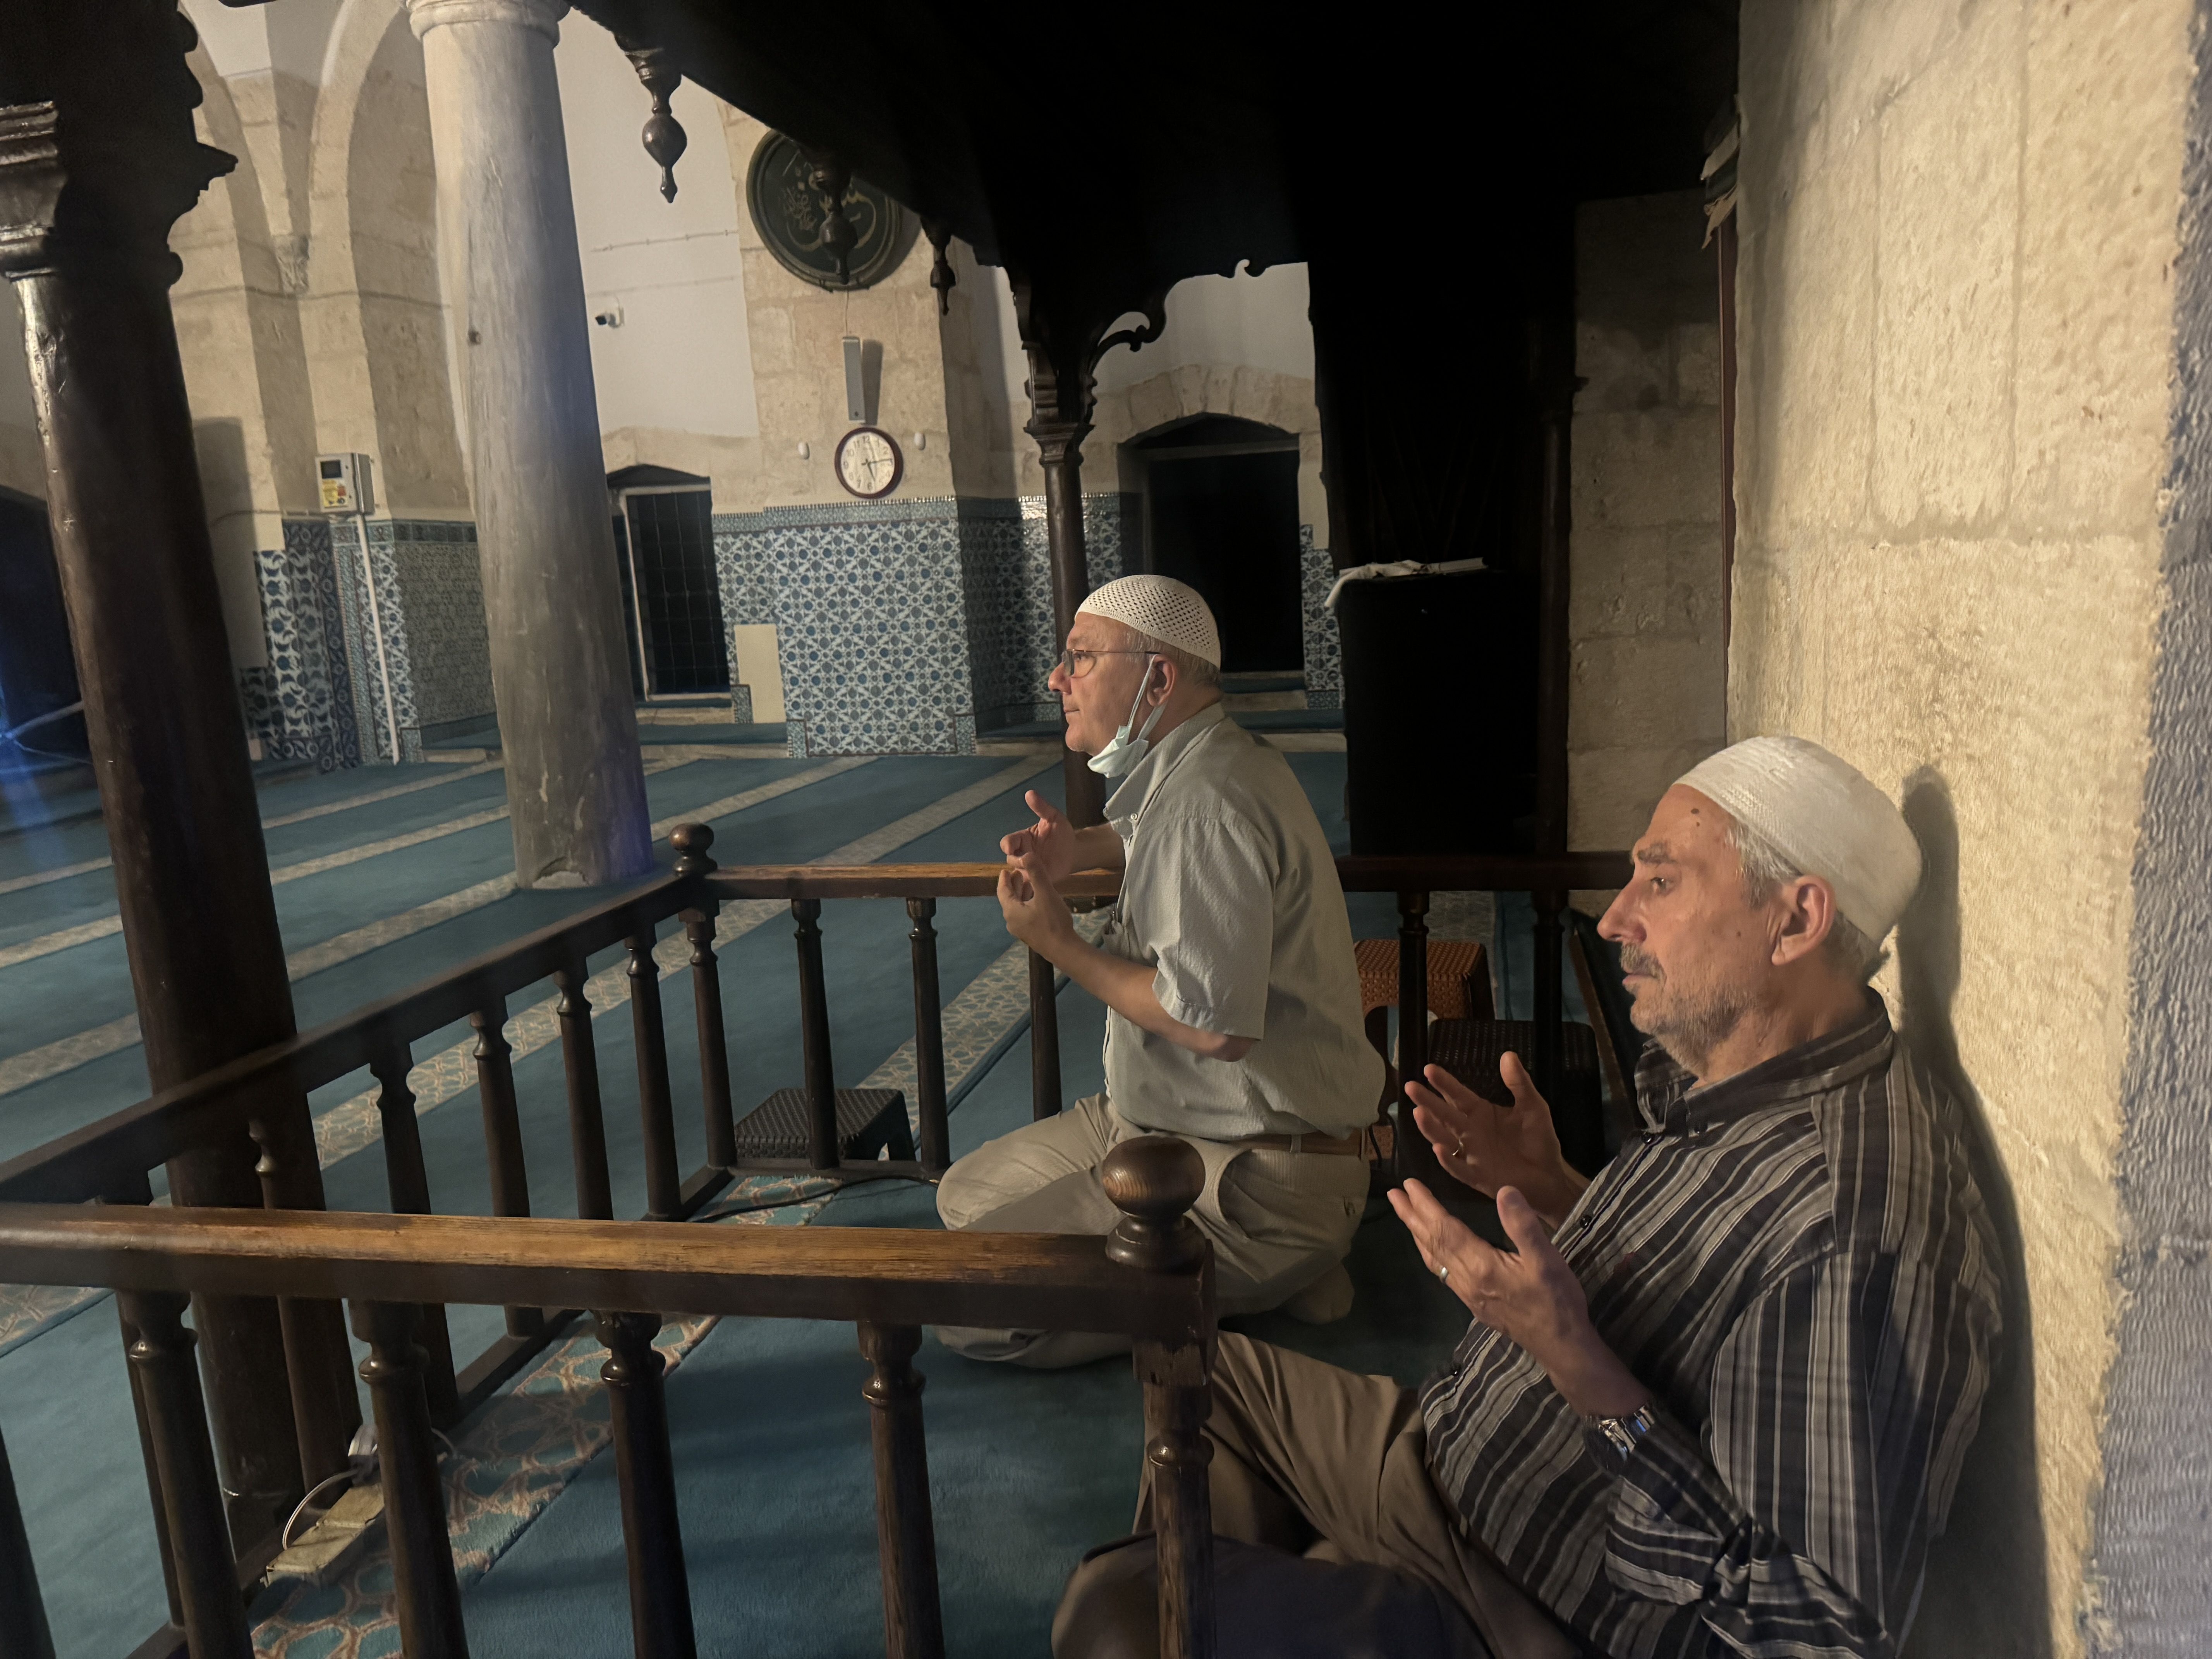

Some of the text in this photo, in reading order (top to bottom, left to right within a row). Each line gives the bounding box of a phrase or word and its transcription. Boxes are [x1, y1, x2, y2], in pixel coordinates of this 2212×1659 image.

[862, 435, 870, 444] 12
[846, 449, 854, 457] 10
[883, 447, 888, 455] 2
[843, 461, 848, 469] 9
[857, 480, 861, 488] 7
